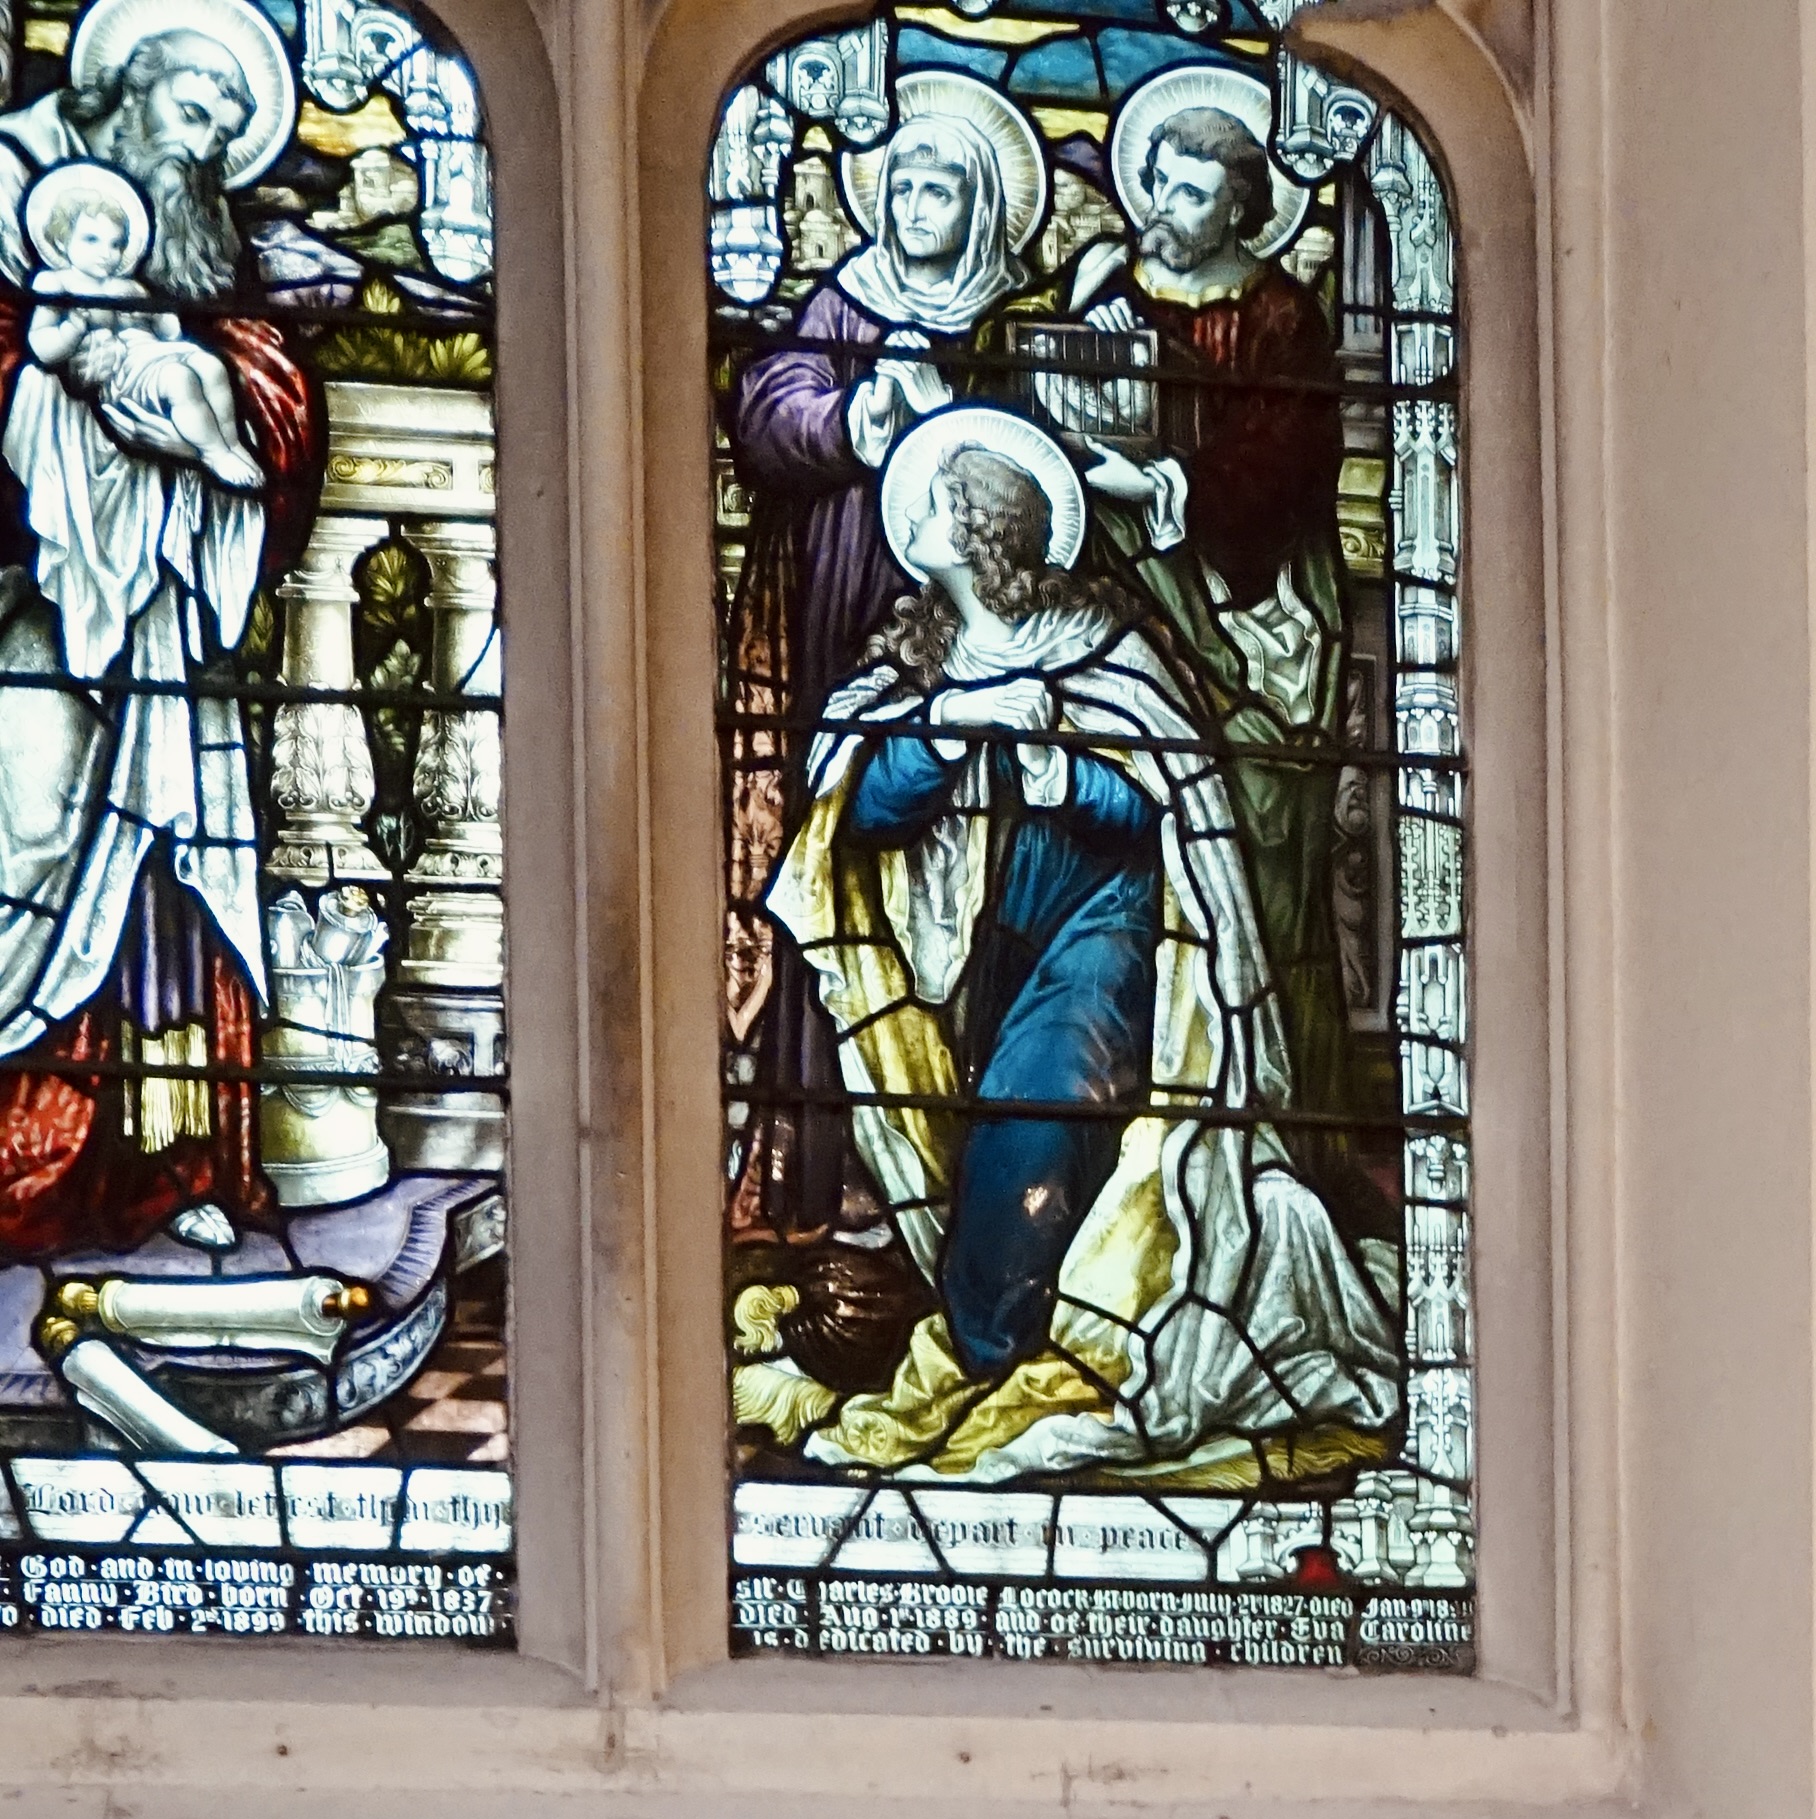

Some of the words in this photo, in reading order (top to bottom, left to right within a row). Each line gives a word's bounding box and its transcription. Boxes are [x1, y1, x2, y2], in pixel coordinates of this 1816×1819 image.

[22, 1483, 116, 1517] Lord
[139, 1489, 213, 1517] ow
[233, 1488, 335, 1521] letest
[356, 1492, 430, 1526] thu
[449, 1495, 502, 1530] thy
[907, 1509, 1018, 1548] depart
[1100, 1524, 1188, 1554] peace
[20, 1554, 85, 1580] God
[101, 1557, 154, 1581] and
[164, 1557, 196, 1582] in
[204, 1558, 296, 1588] loving
[312, 1562, 443, 1590] memory
[456, 1563, 491, 1588] of
[23, 1579, 118, 1607] Fanny
[132, 1581, 203, 1607] Bird
[221, 1582, 289, 1609] born
[309, 1585, 363, 1611] Oct
[429, 1590, 494, 1613] 1837
[786, 1578, 897, 1607] Carles
[1121, 1589, 1181, 1613] born
[1263, 1594, 1304, 1618] 1827
[1308, 1596, 1354, 1619] died
[1361, 1597, 1408, 1620] Jan
[41, 1604, 102, 1629] died
[119, 1605, 174, 1631] Feb
[301, 1608, 360, 1635] this
[373, 1609, 495, 1637] window
[738, 1604, 798, 1626] died
[818, 1605, 880, 1632] Aug
[914, 1608, 978, 1632] 1889
[995, 1610, 1041, 1634] and
[1050, 1612, 1081, 1635] of
[1088, 1611, 1151, 1638] their
[1160, 1614, 1280, 1641] daughter
[1359, 1618, 1473, 1644] Caroline
[950, 1631, 984, 1659] by
[1004, 1633, 1047, 1660] the
[1067, 1634, 1207, 1663] surviving
[1230, 1640, 1344, 1667] children
